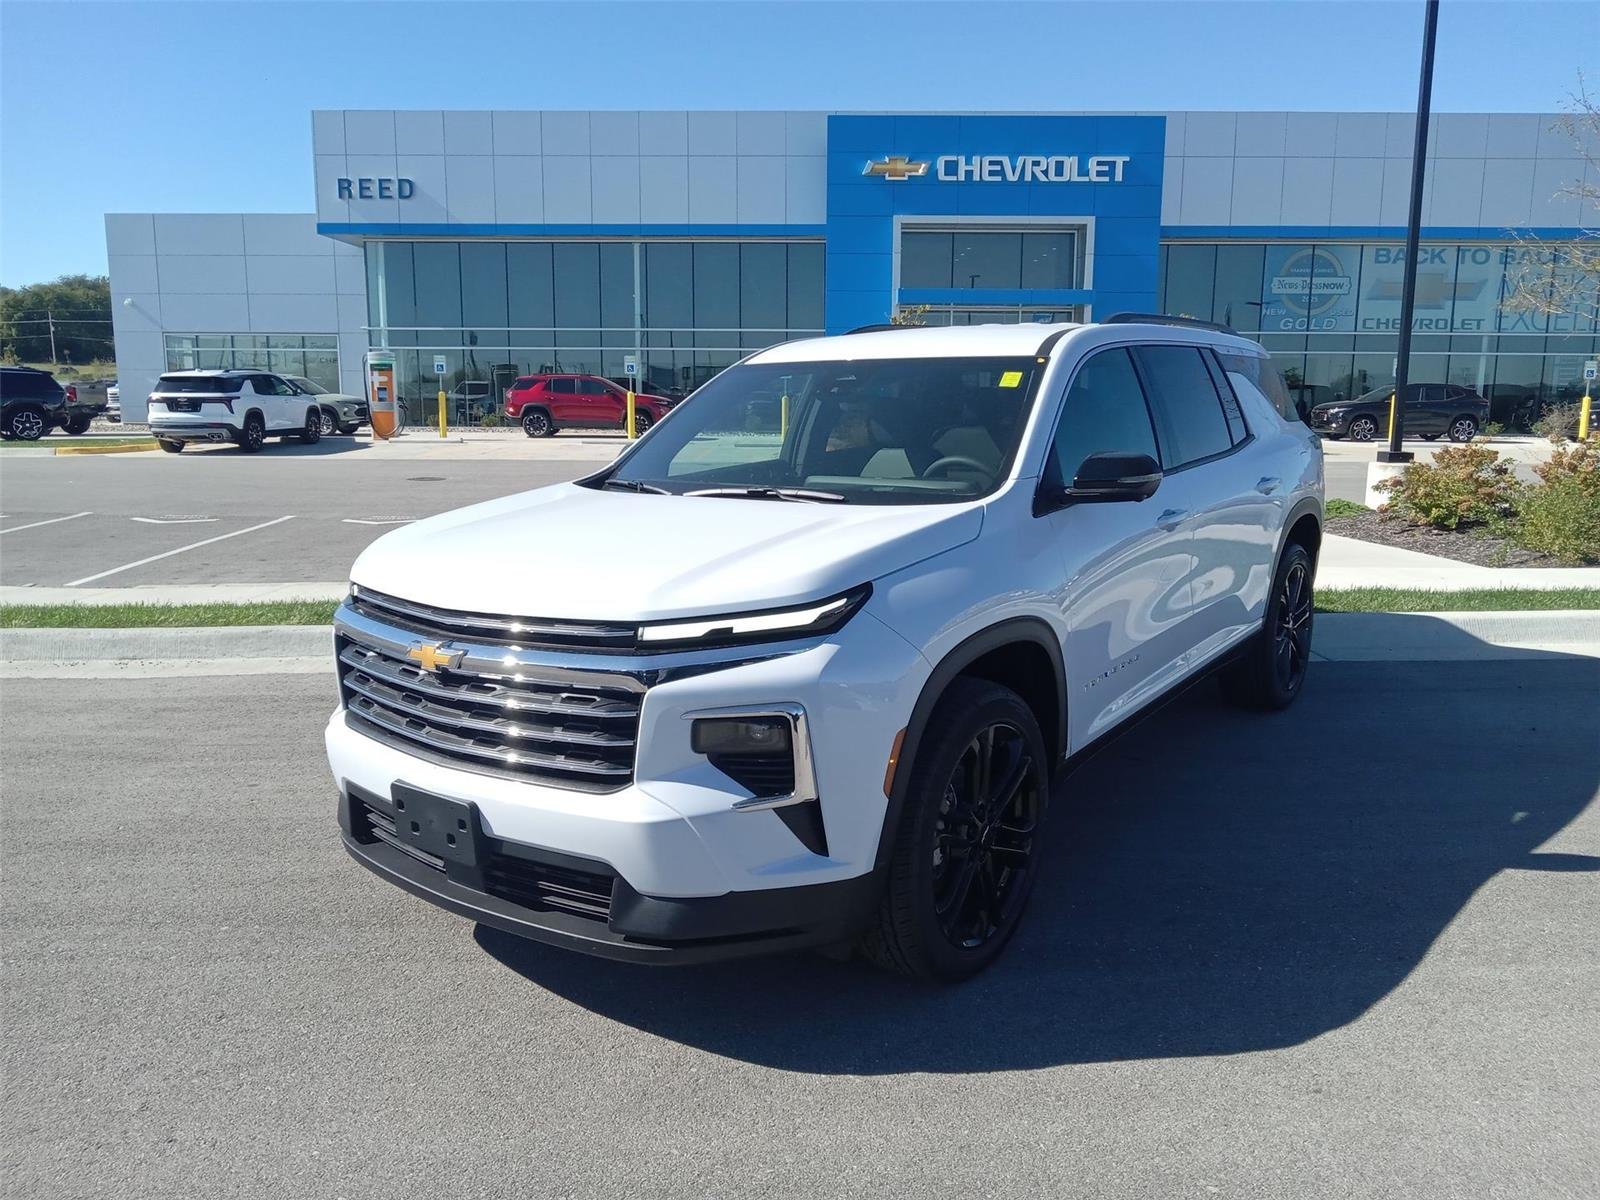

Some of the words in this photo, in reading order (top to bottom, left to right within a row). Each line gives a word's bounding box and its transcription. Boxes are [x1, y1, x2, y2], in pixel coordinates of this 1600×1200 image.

[936, 155, 1130, 182] CHEVROLET
[337, 178, 414, 200] REED
[1374, 247, 1448, 264] BACK
[1459, 248, 1491, 265] TO
[1279, 318, 1337, 330] GOLD
